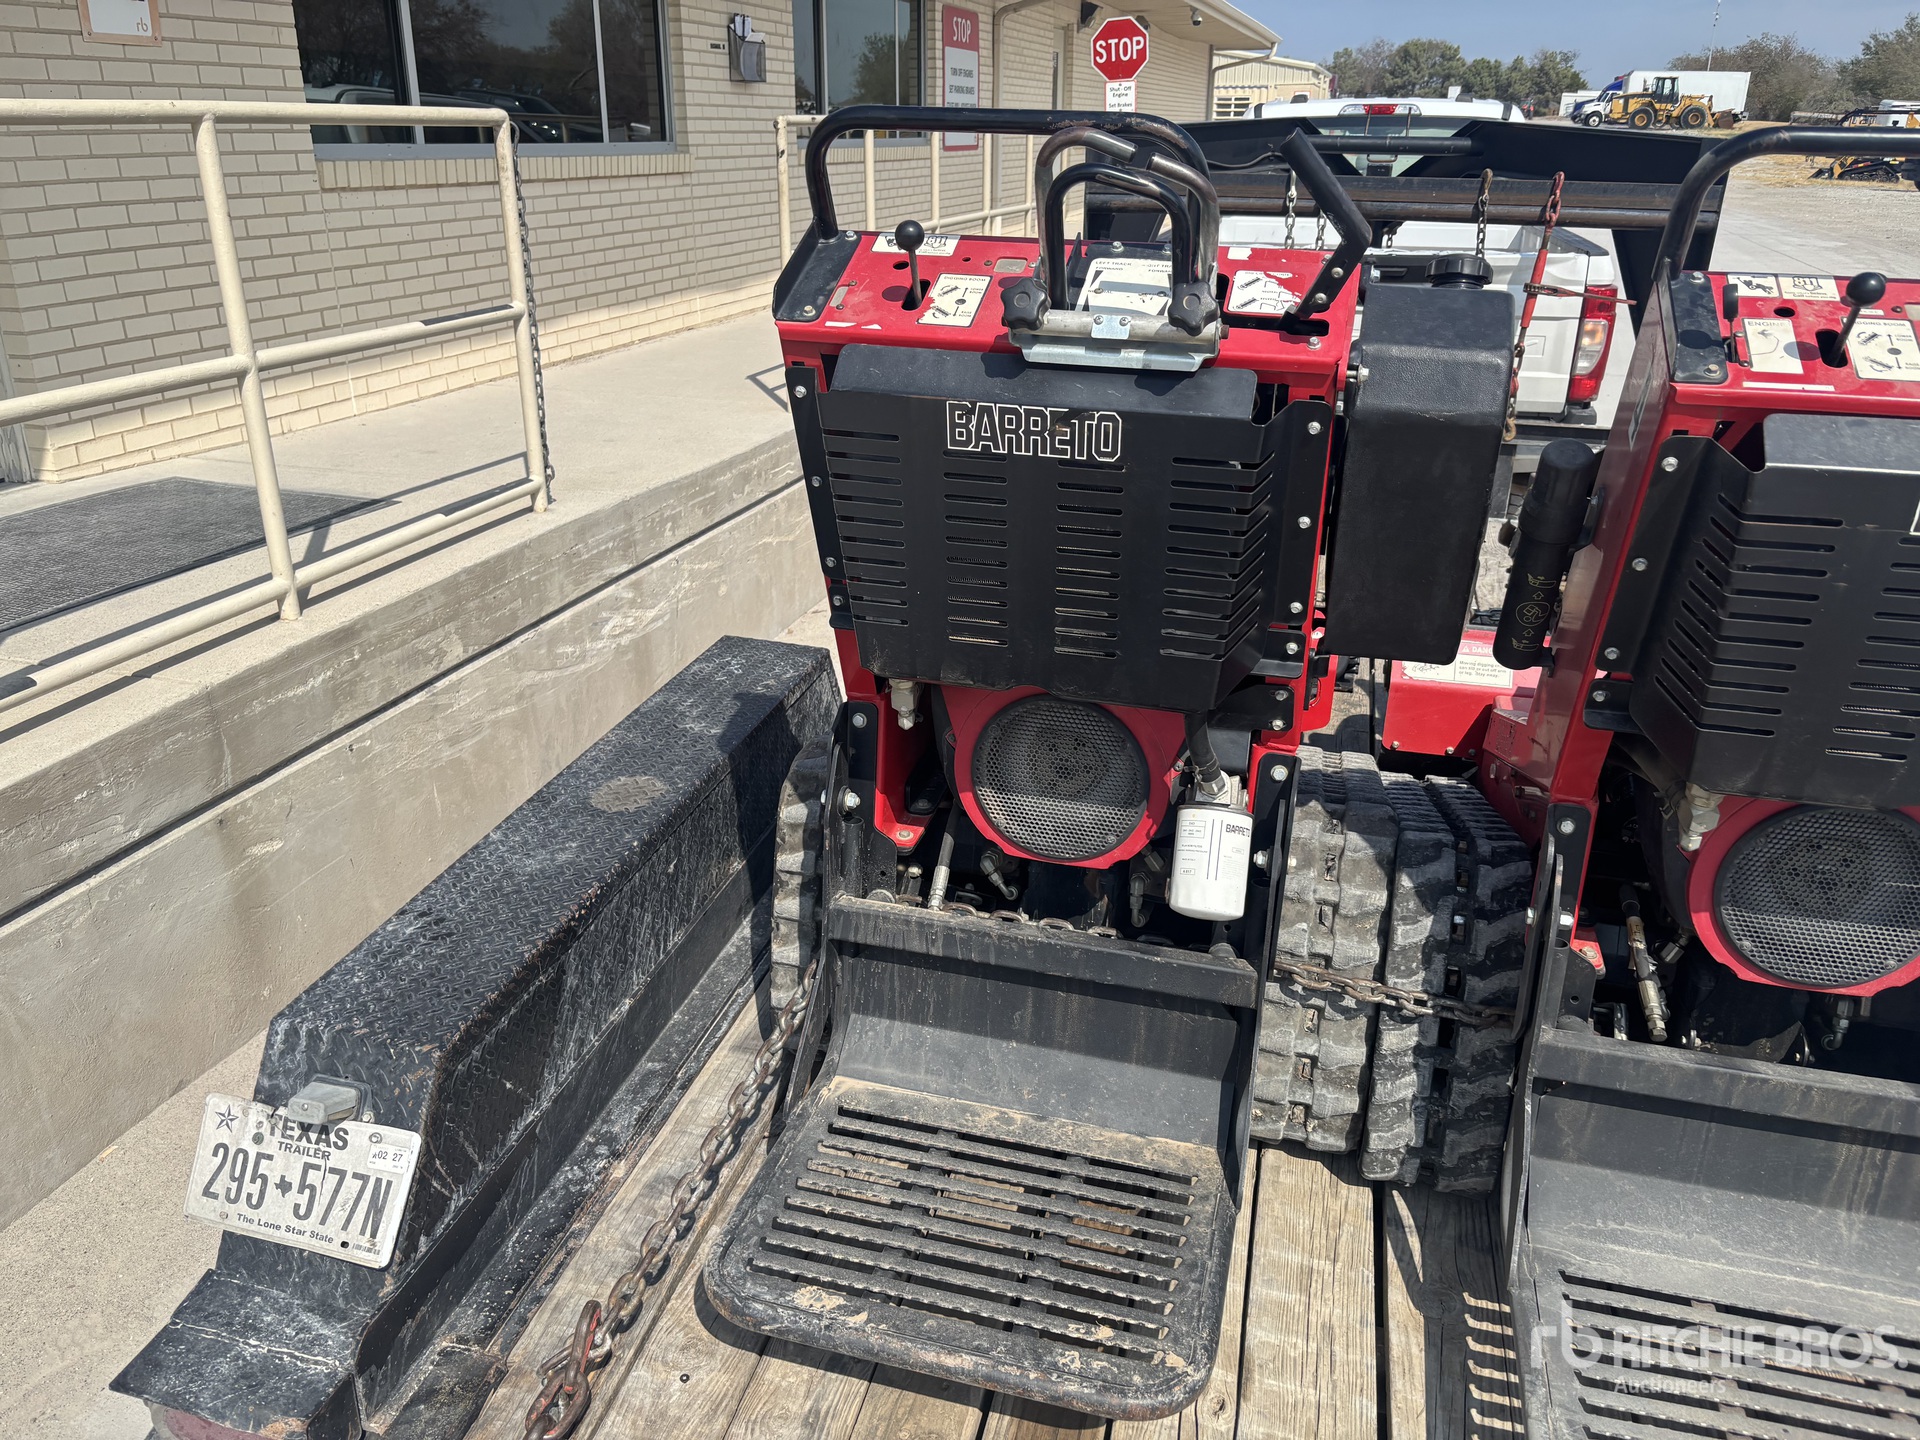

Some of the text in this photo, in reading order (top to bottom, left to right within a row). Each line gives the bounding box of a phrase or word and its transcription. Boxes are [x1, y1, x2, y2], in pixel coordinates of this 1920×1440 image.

[136, 17, 148, 32] rb
[952, 16, 971, 43] STOP
[1095, 36, 1145, 64] STOP
[946, 400, 1122, 463] BARRETO
[269, 1112, 350, 1151] TEXAS
[277, 1140, 332, 1161] TRAILER
[377, 1150, 404, 1162] 02 27
[201, 1142, 394, 1240] 295 577N
[236, 1212, 334, 1244] The Lone Star State
